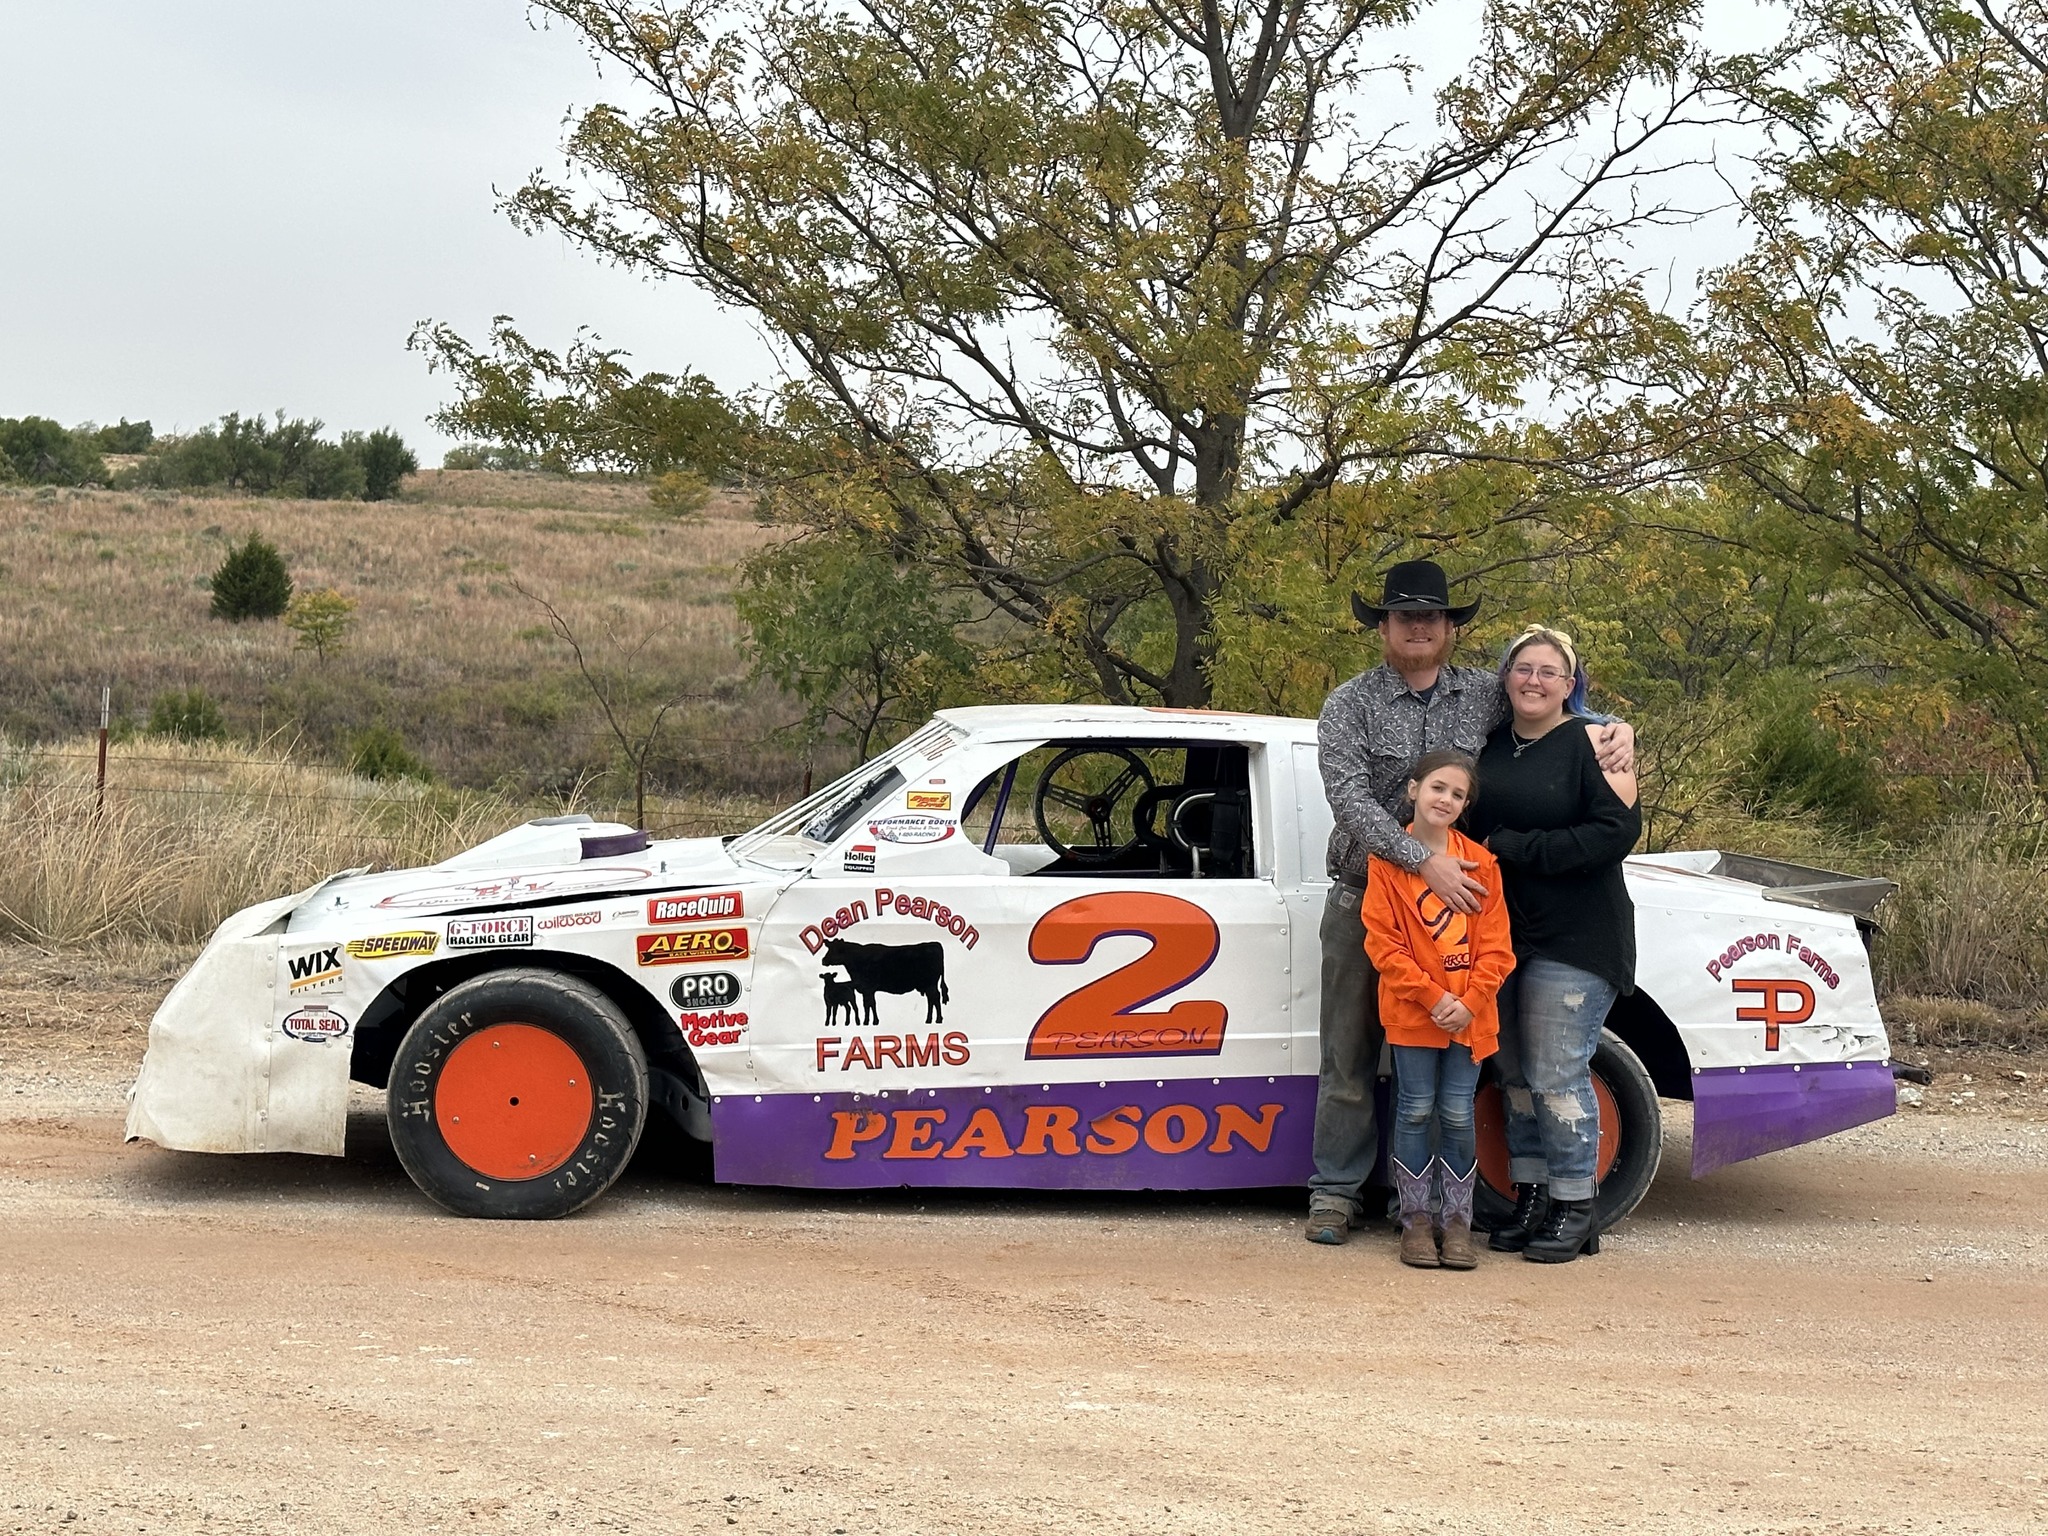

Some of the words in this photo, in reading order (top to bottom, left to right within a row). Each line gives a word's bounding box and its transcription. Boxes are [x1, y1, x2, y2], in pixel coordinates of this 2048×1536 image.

[844, 851, 876, 864] Holley
[844, 864, 874, 872] EQUIPPED
[655, 896, 735, 919] RaceQuip
[450, 919, 529, 935] G-FORCE
[537, 911, 601, 930] wilwood
[799, 900, 869, 956] Dean
[875, 888, 980, 951] Pearson
[365, 935, 438, 952] SPEEDWAY
[450, 934, 495, 945] RACING
[499, 933, 529, 944] GEAR
[647, 932, 733, 953] AERO
[288, 946, 342, 980] WIX
[1440, 952, 1470, 966] ARSO
[1705, 933, 1780, 983] Pearson
[1786, 934, 1840, 990] Farms
[290, 976, 343, 996] FILTERS
[682, 974, 729, 998] PRO
[1024, 890, 1229, 1061] 2
[686, 996, 729, 1007] SHOCKS
[289, 1018, 316, 1031] TOTAL
[319, 1018, 342, 1031] SEAL
[680, 1010, 749, 1031] Motive
[688, 1029, 741, 1047] Gear
[1046, 1026, 1211, 1051] PEARSON
[816, 1031, 971, 1072] FARMS
[401, 1012, 474, 1123] Hoosier
[823, 1104, 1285, 1160] PEARSON
